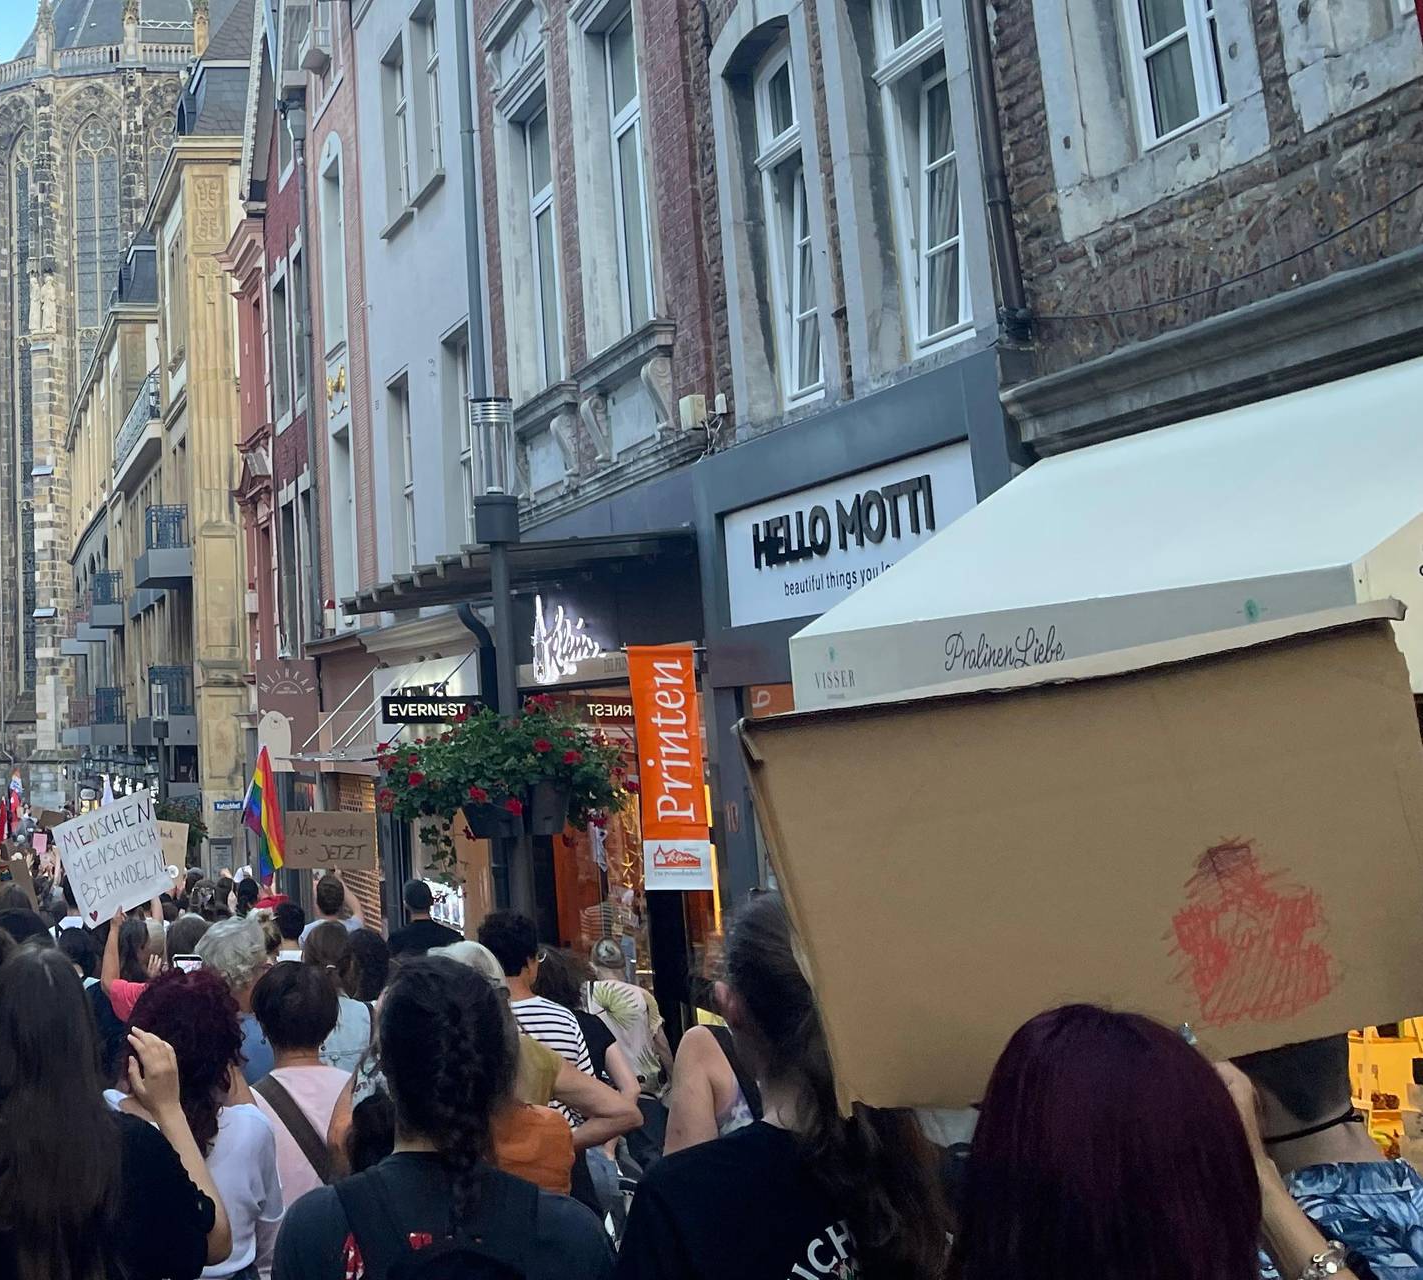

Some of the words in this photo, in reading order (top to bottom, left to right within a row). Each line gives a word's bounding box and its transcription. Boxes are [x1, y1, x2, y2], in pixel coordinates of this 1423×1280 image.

[752, 506, 832, 569] HELLO
[836, 475, 936, 550] MOTTI
[784, 575, 824, 596] beautiful
[826, 569, 858, 589] things
[814, 669, 856, 689] VISSER
[389, 703, 466, 718] EVERNEST
[647, 658, 696, 823] Printen
[63, 797, 151, 854] MENSCHEN
[291, 818, 318, 838] Nie
[323, 824, 368, 838] wieder
[73, 827, 157, 876] MENSCHLICH
[317, 844, 368, 862] JETZT
[80, 850, 168, 908] BEHANDELN!
